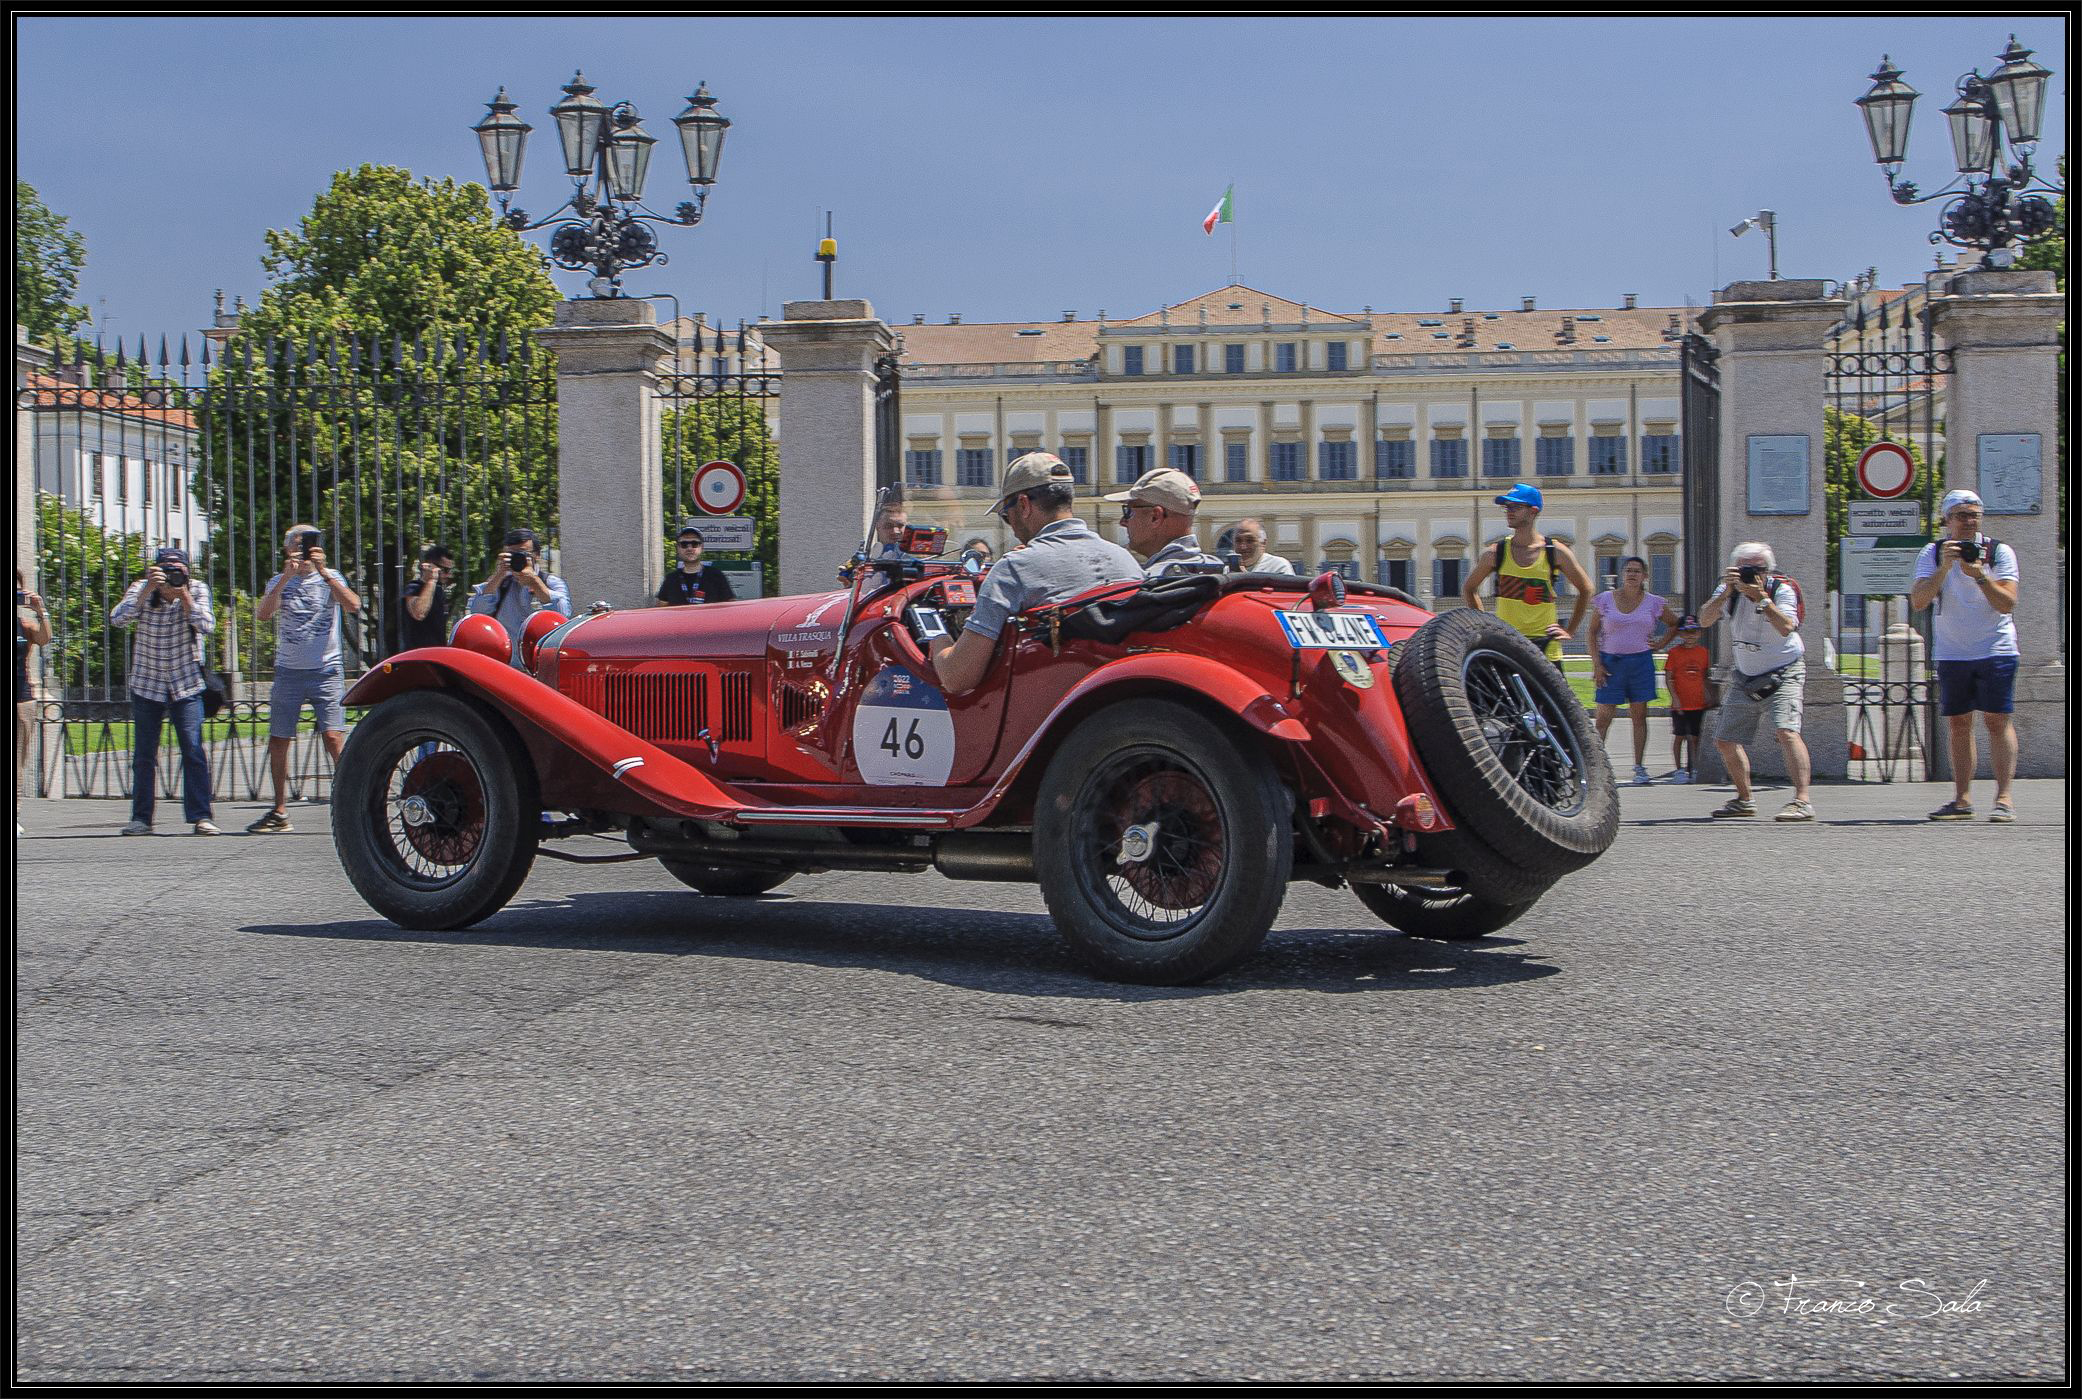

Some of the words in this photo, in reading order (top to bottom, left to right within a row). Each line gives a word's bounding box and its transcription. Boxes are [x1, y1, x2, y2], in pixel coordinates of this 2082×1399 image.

[777, 633, 798, 643] VILLA
[799, 631, 832, 642] TRASQUA
[893, 674, 911, 683] 2022
[880, 716, 925, 760] 46
